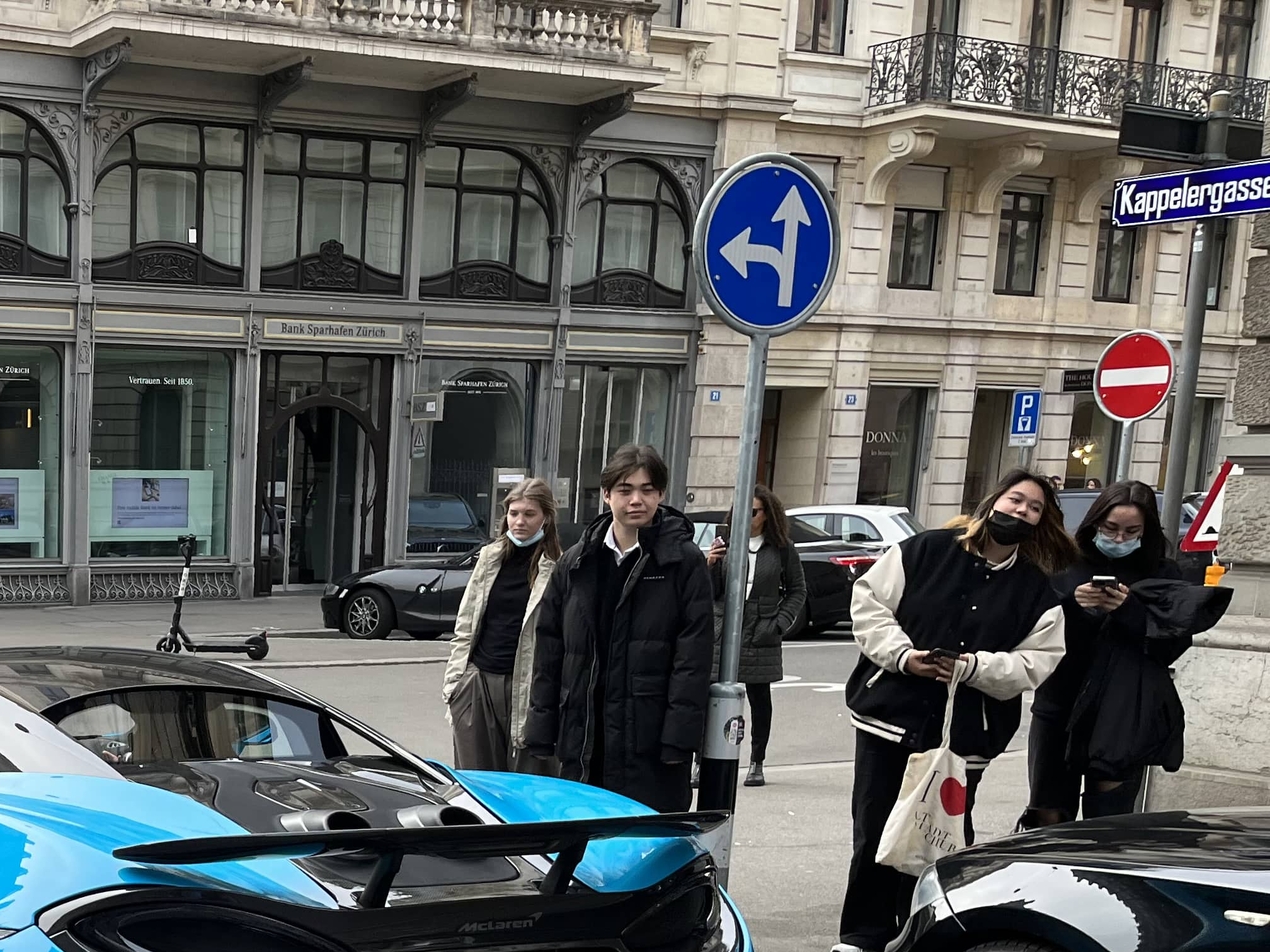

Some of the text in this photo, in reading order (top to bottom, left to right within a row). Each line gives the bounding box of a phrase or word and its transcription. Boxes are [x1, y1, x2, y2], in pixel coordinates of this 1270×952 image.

[1119, 176, 1270, 220] Kappelergasse
[281, 322, 386, 338] Bank Sparhafen Zürich
[163, 376, 176, 385] Seit
[711, 392, 719, 400] 21
[847, 395, 855, 404] 23
[1021, 395, 1034, 415] P
[865, 431, 907, 443] DONNA
[458, 917, 534, 933] McLaren
